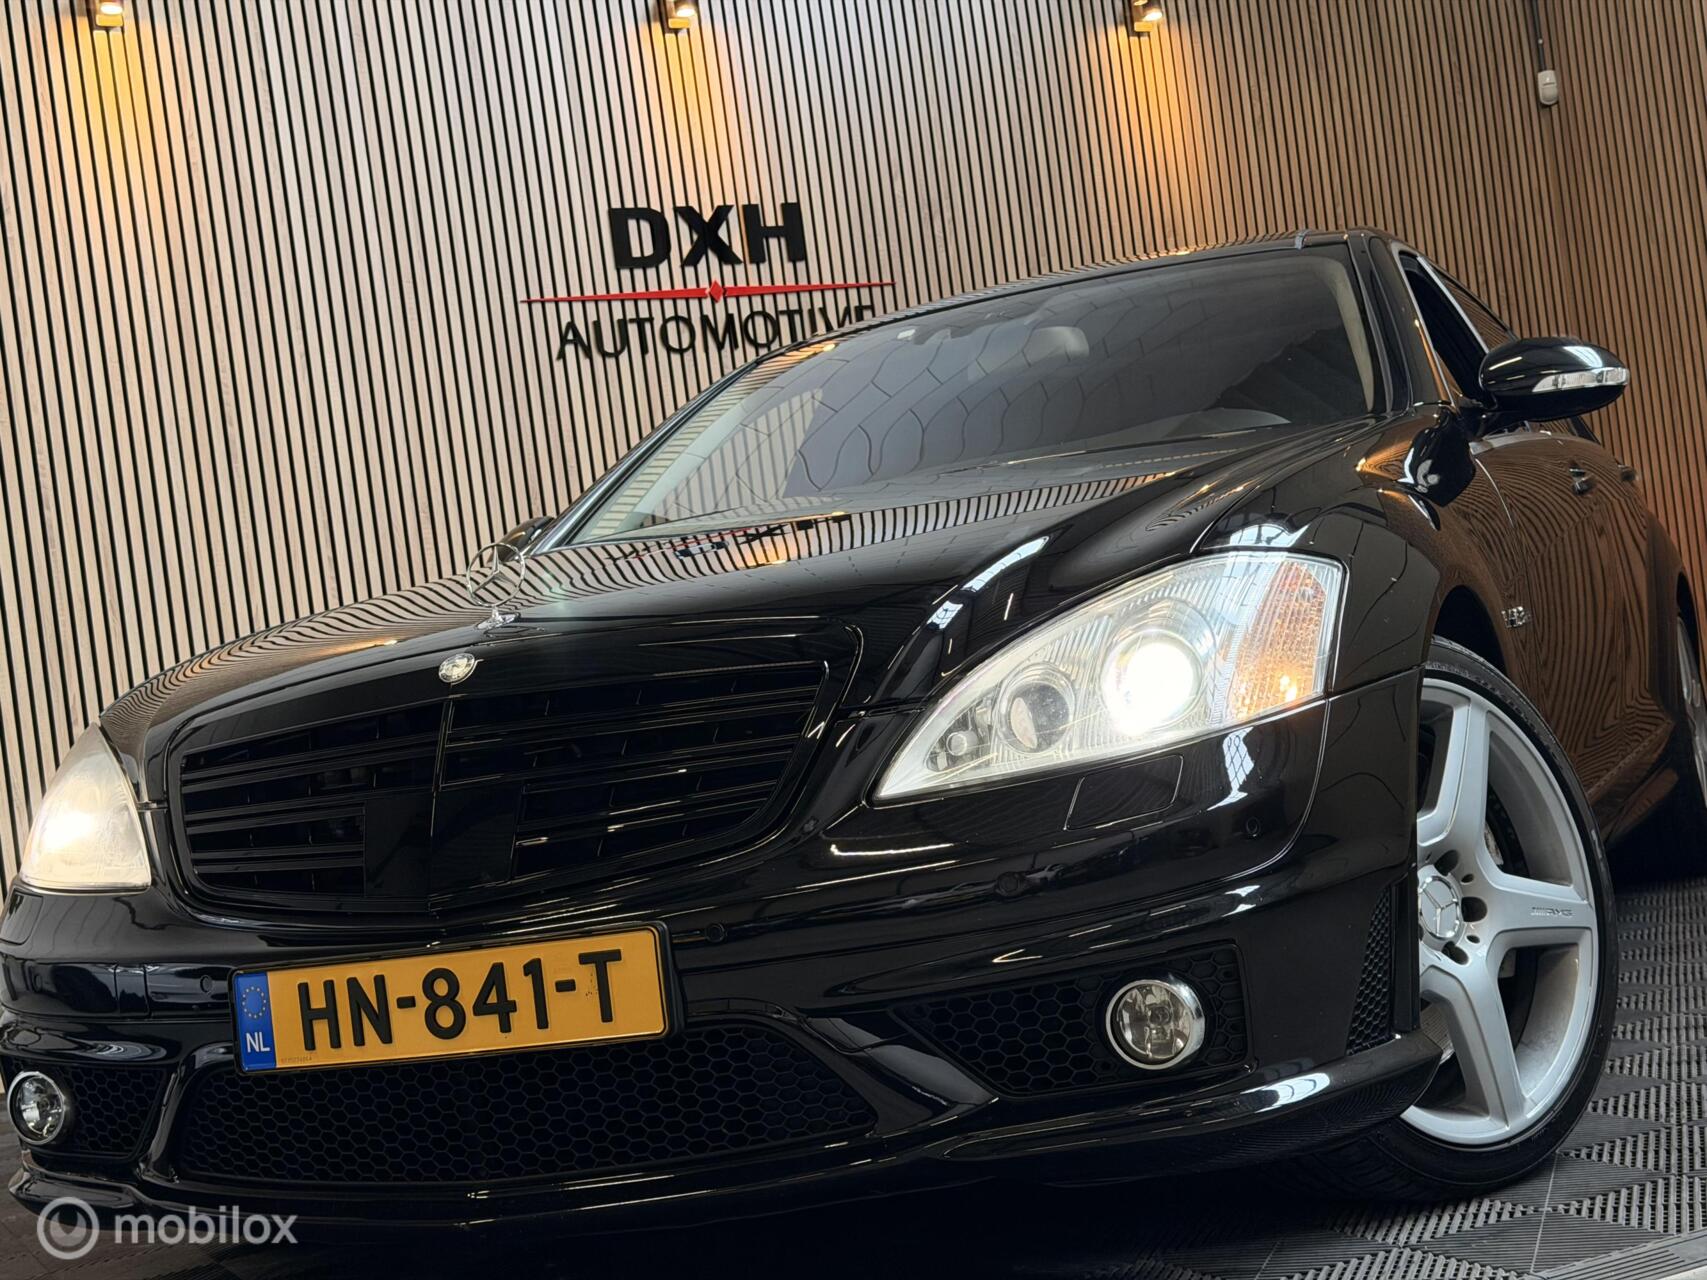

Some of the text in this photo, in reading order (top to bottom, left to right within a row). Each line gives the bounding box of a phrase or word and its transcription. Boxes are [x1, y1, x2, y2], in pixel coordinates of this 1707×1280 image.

[609, 202, 805, 269] DXH
[297, 948, 622, 1051] HN-841-T
[246, 1032, 270, 1053] NL
